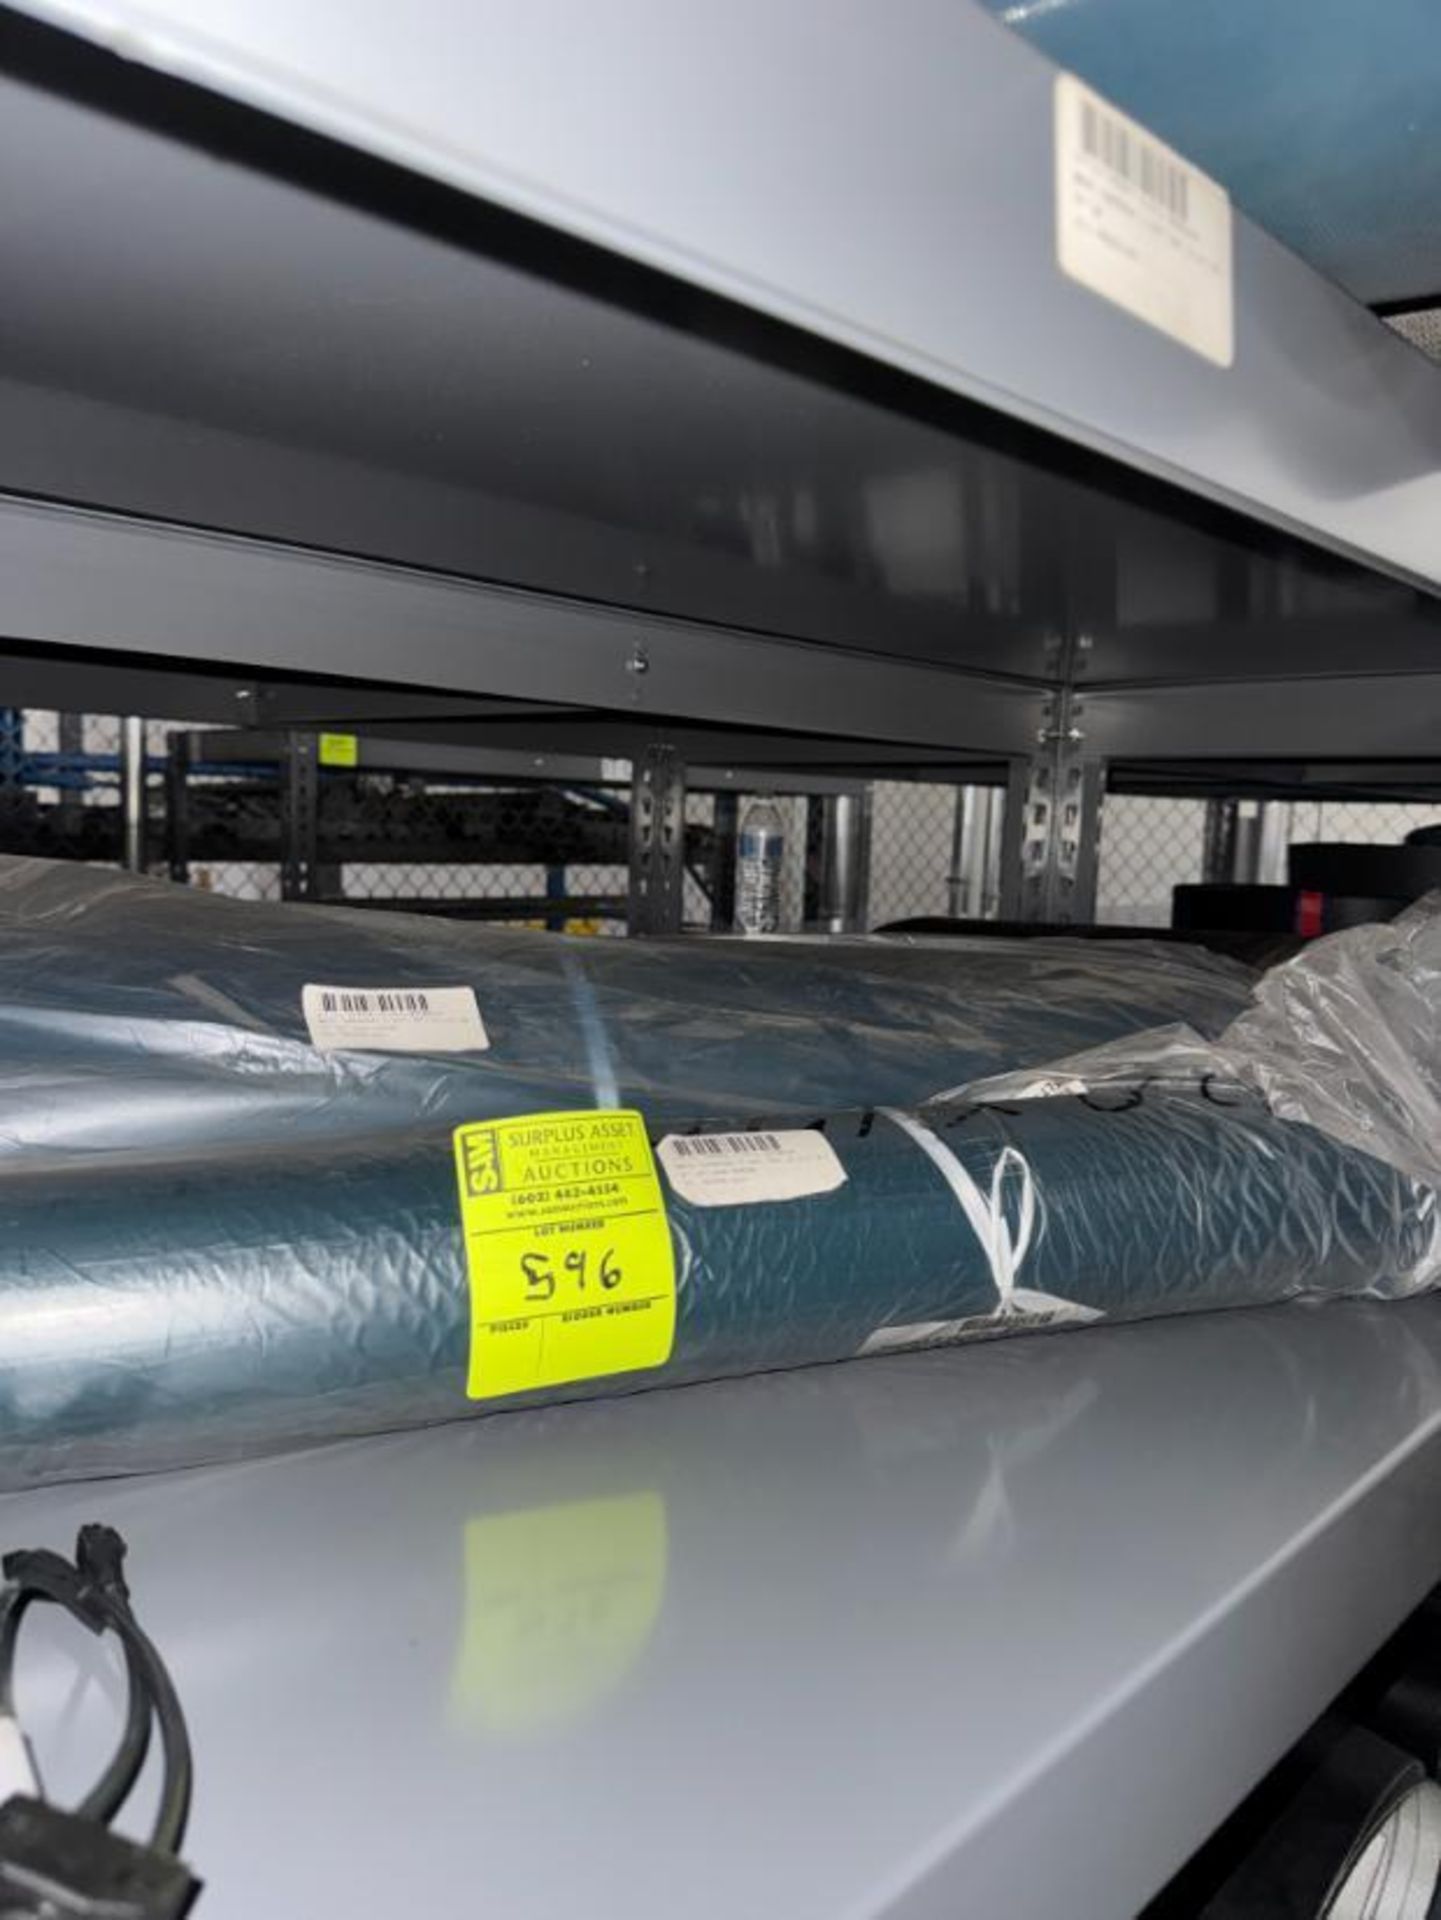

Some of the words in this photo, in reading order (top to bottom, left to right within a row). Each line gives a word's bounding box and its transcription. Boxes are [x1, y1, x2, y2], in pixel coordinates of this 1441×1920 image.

[508, 1125, 584, 1146] SURPLUS
[591, 1121, 634, 1139] ASSET
[523, 1157, 633, 1182] AUCTIONS
[521, 1248, 622, 1301] 596
